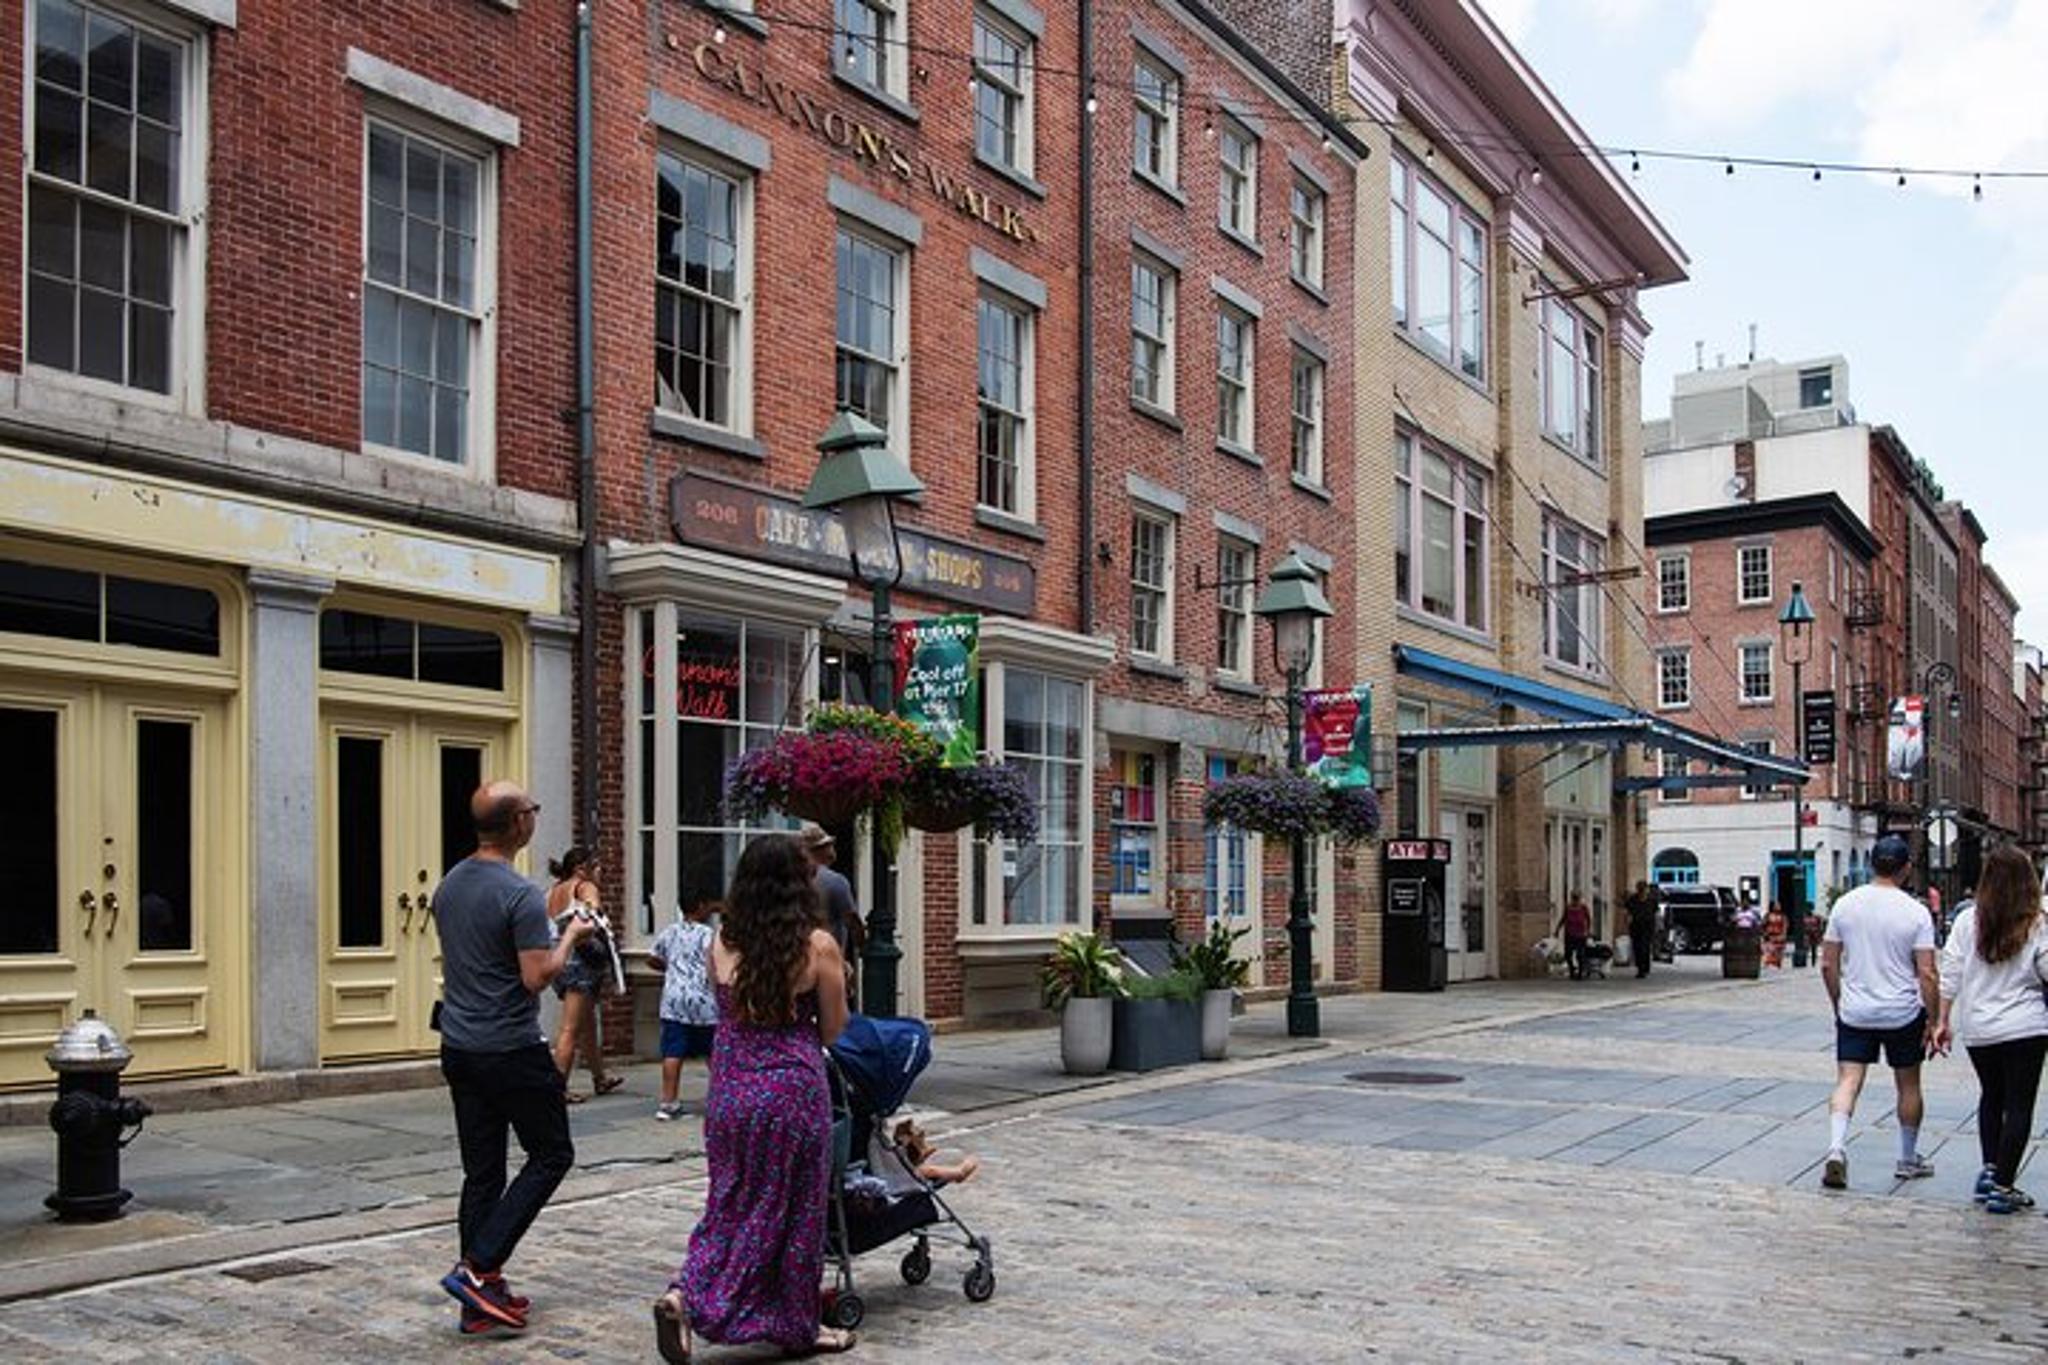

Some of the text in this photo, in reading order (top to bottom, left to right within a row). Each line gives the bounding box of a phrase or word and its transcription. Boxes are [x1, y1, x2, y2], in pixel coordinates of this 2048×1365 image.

[693, 44, 1026, 241] CANNON'S WALK
[756, 504, 812, 550] CAFE
[927, 547, 982, 590] SHOPS
[907, 662, 965, 682] Cool off
[923, 682, 950, 698] Pier
[953, 681, 968, 697] 17
[1390, 842, 1427, 857] ATM
